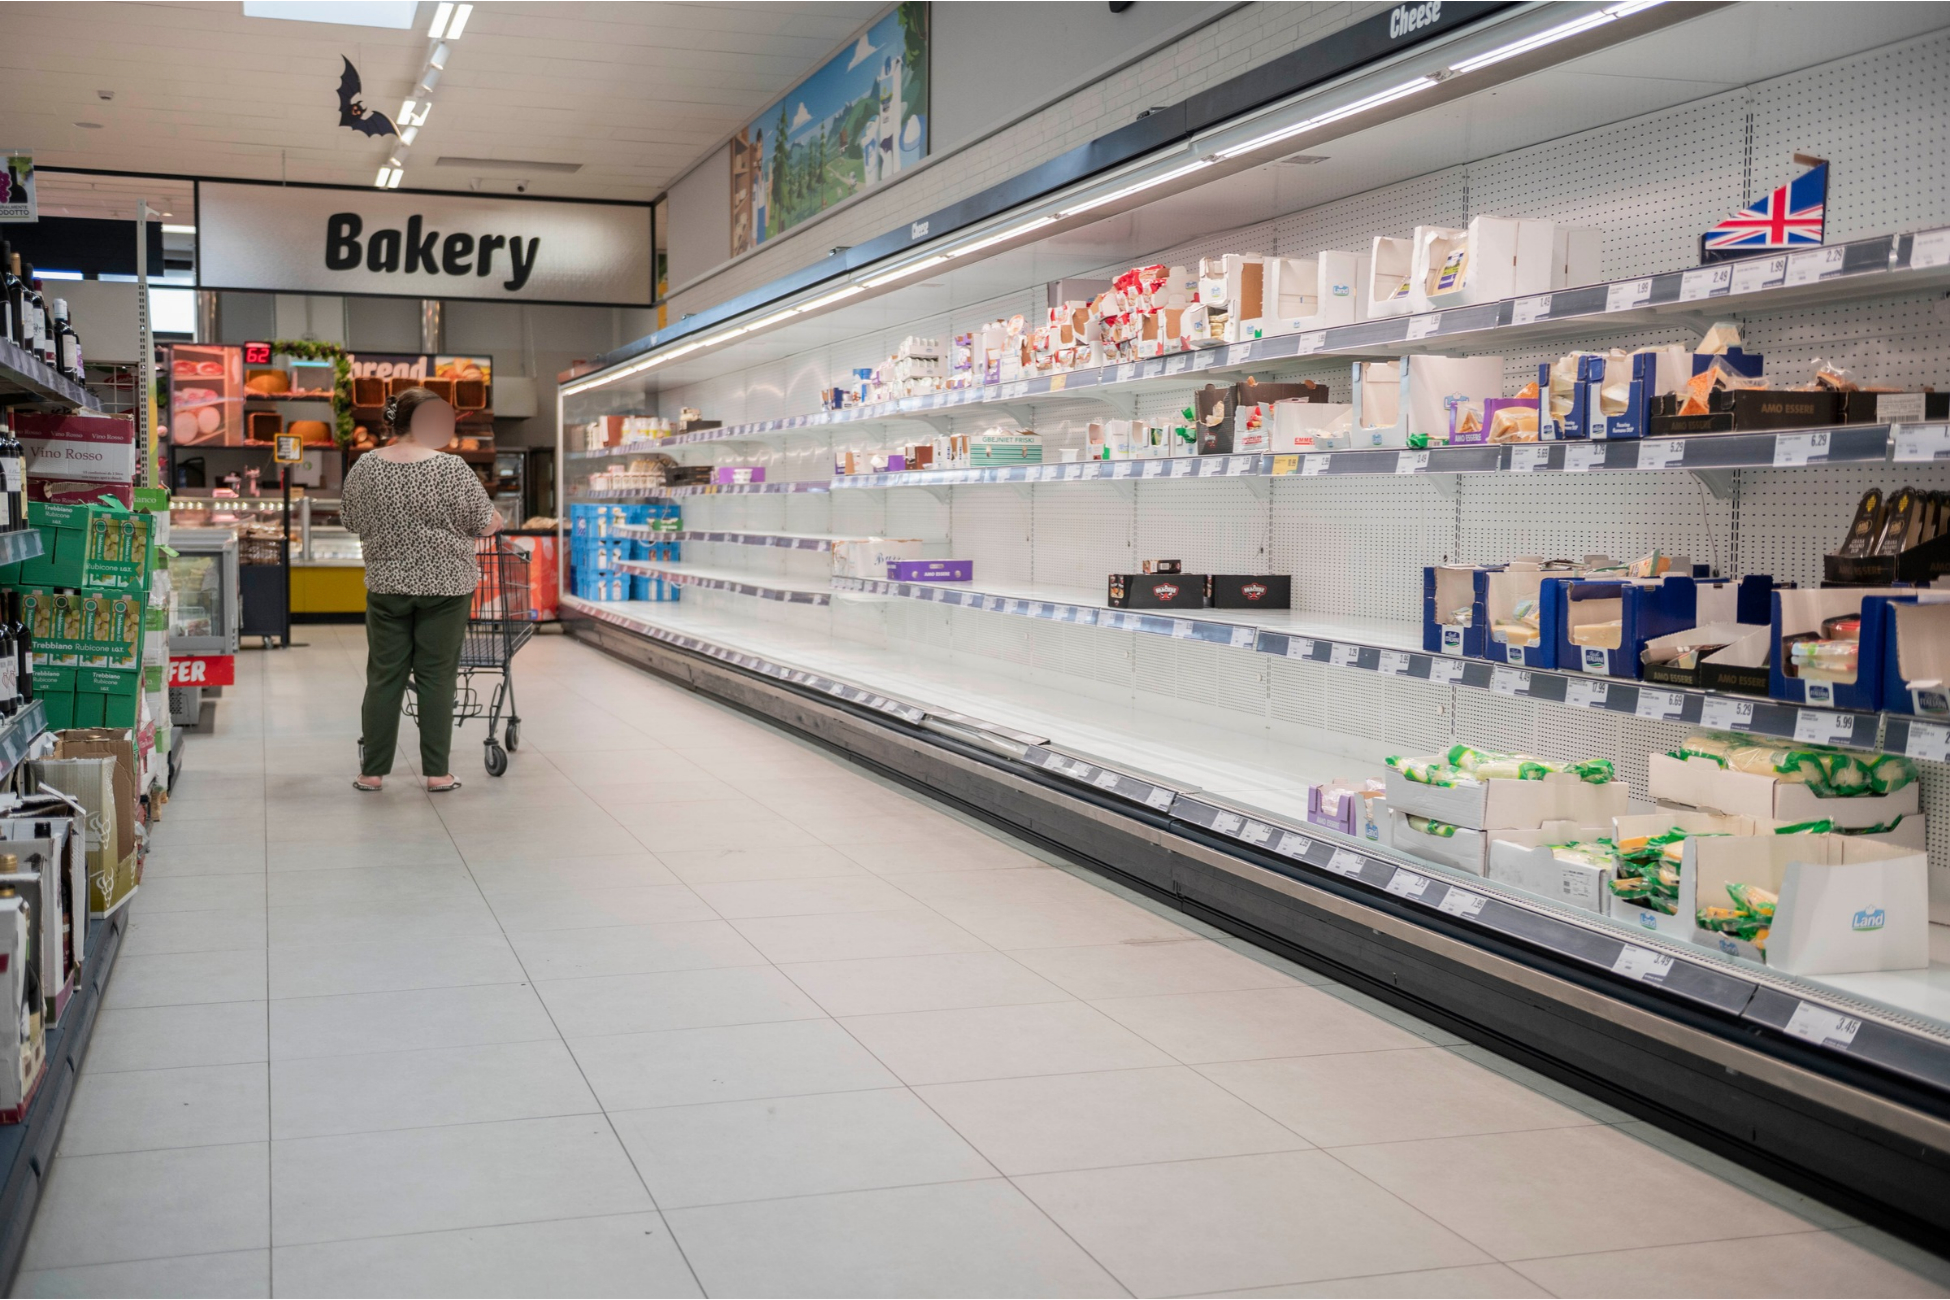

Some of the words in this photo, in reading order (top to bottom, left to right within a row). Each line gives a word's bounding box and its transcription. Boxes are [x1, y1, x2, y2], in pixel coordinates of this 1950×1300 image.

[1390, 1, 1442, 39] Cheese
[325, 212, 541, 291] Bakery
[1826, 247, 1843, 263] 2.29
[1770, 260, 1784, 273] 1.99
[1713, 270, 1728, 284] 2.49
[1637, 281, 1649, 295] 1.99
[245, 347, 270, 363] 62
[1761, 403, 1783, 414] AMO
[1785, 404, 1815, 415] ESSERE
[51, 430, 64, 438] Vino
[65, 431, 83, 439] Rosso
[91, 432, 106, 440] Vino
[106, 433, 125, 441] Rosso
[1454, 434, 1466, 443] AMO
[1811, 434, 1827, 447] 6.29
[30, 446, 62, 459] Vino
[65, 448, 103, 462] Rosso
[1670, 441, 1684, 454] 5.29
[44, 504, 73, 513] Trebbiano
[45, 511, 71, 519] Rubicone
[87, 562, 118, 572] Rubicone
[32, 641, 73, 650] Trebbiano
[75, 643, 110, 653] Rubicone
[92, 671, 121, 680] Trebbiano
[169, 660, 206, 683] FER
[1653, 671, 1669, 681] AMO
[1670, 673, 1693, 684] ESSERE
[1717, 673, 1738, 684] AMO
[1738, 675, 1766, 687] ESSERE
[1736, 702, 1752, 716] 5.29
[1836, 715, 1853, 729] 5.99
[1853, 912, 1883, 927] Land
[1653, 953, 1671, 967] 3.49
[1836, 1016, 1859, 1035] 3.45
